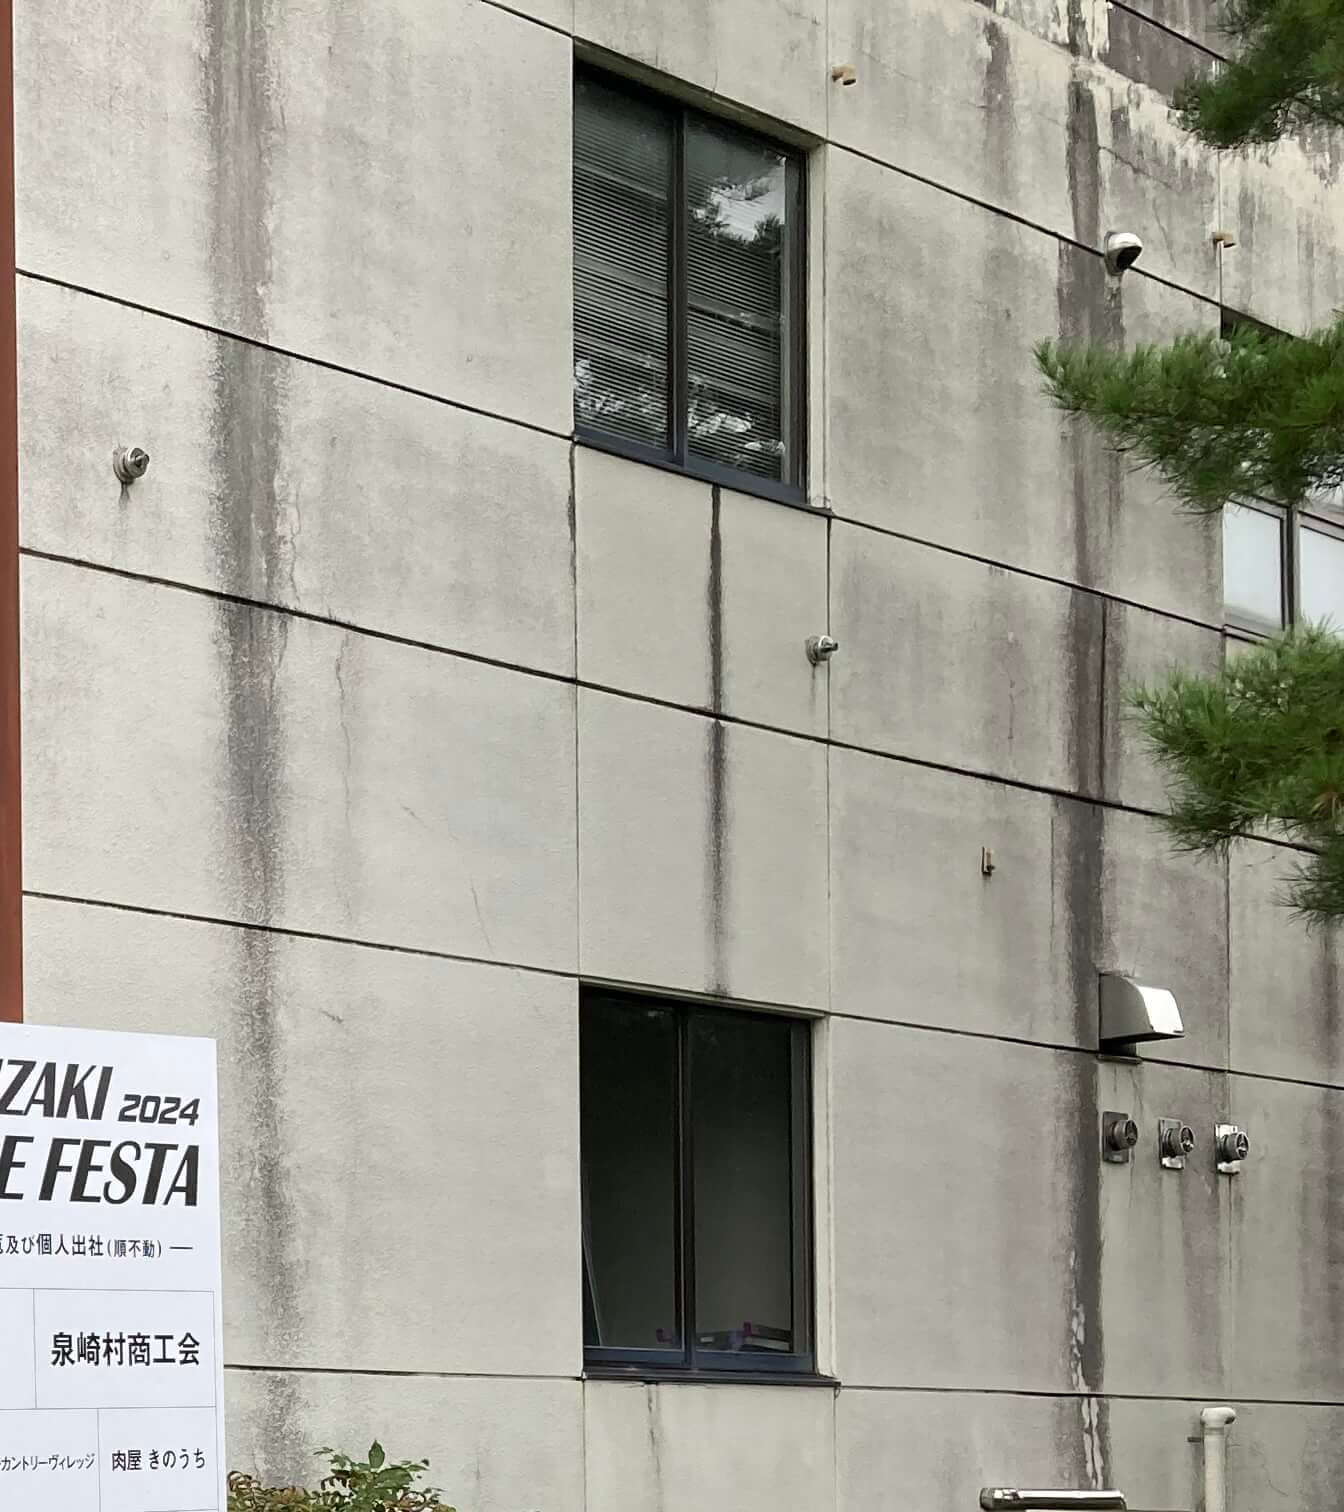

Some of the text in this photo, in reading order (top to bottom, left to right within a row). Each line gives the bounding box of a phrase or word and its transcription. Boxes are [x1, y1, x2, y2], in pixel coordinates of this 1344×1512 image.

[116, 1093, 201, 1127] 2024
[37, 1136, 200, 1208] FESTA
[49, 1330, 201, 1369] 泉崎村商工会
[111, 1447, 206, 1473] 肉屋 きのうち
